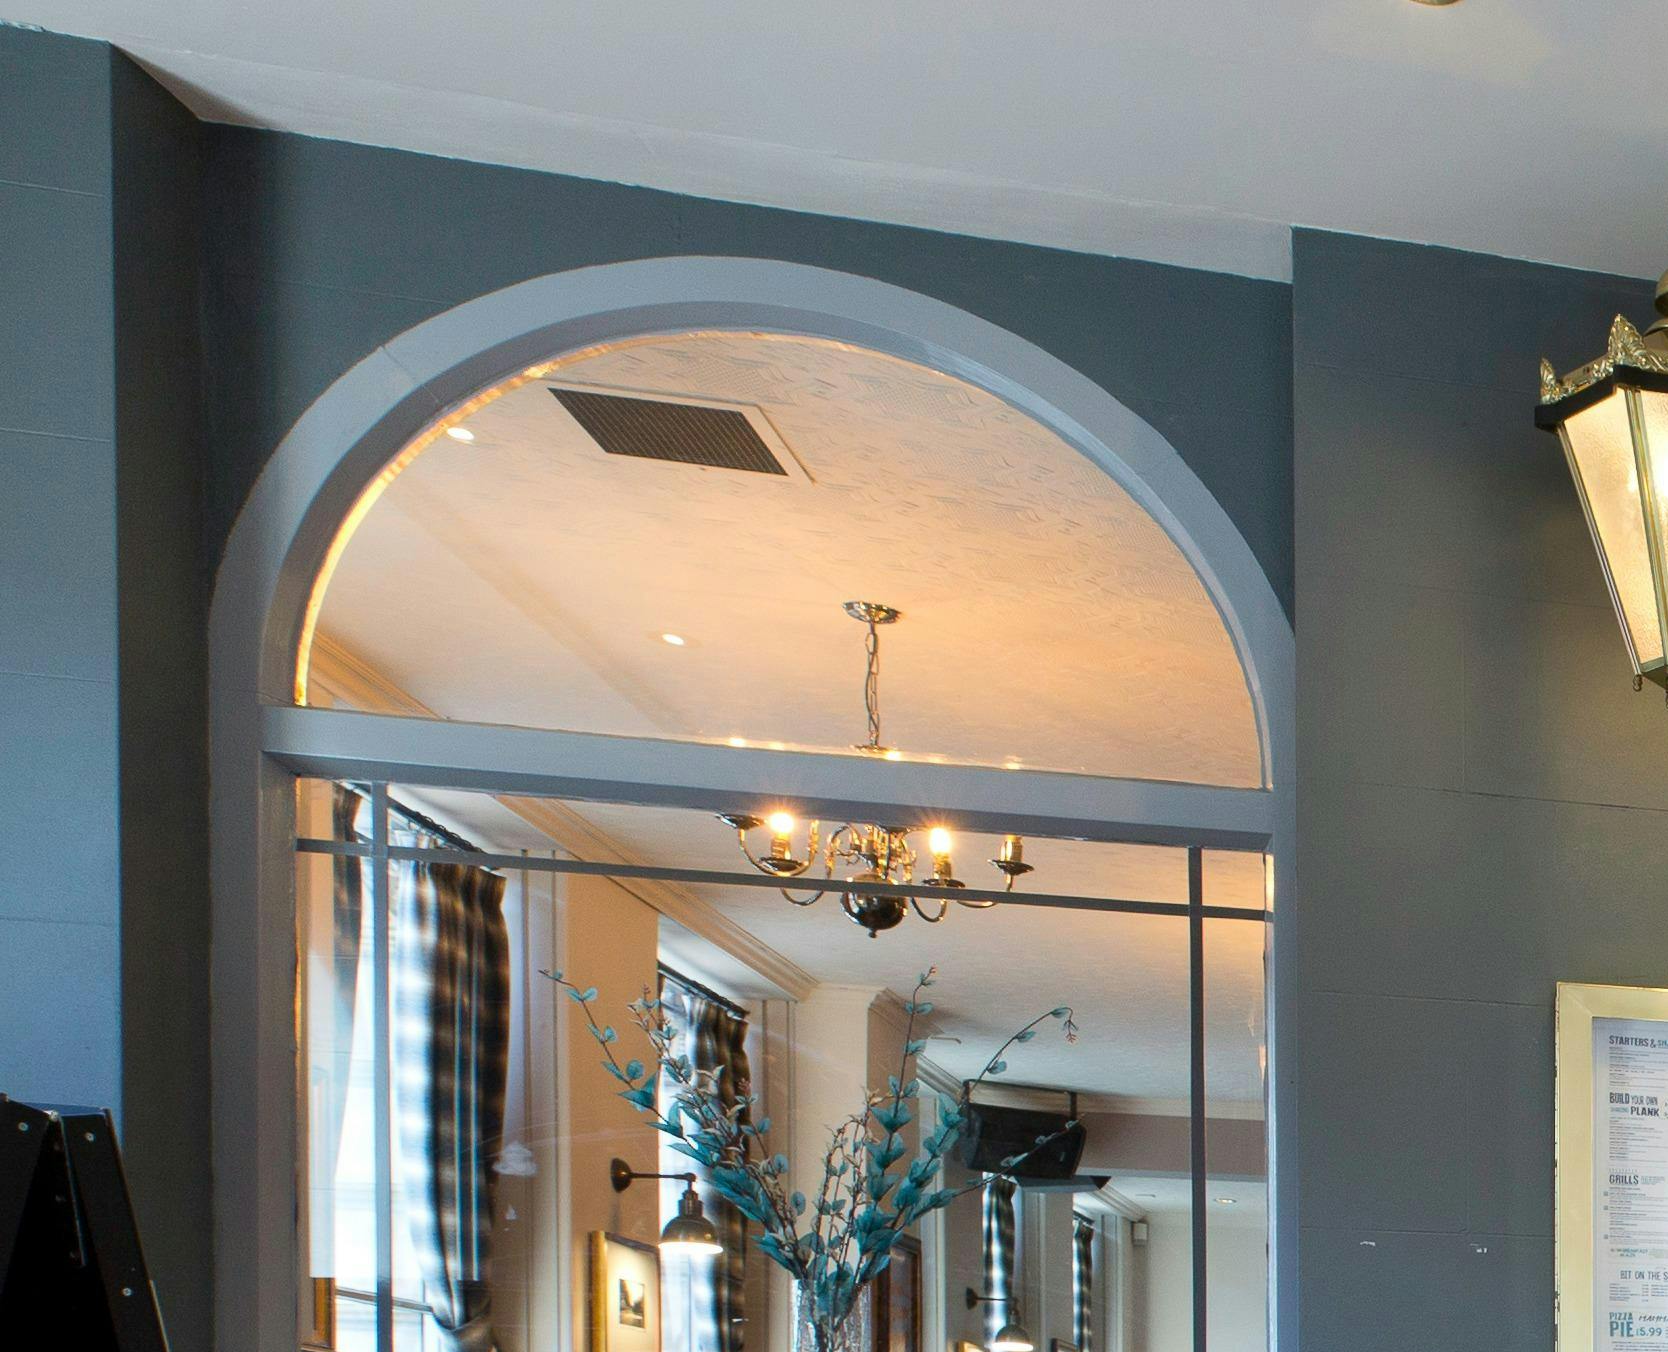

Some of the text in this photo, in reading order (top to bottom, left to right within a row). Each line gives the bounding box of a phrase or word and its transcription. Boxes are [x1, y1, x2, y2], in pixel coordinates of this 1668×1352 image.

[1609, 1035, 1649, 1047] STARTERS
[1631, 1106, 1659, 1116] PLANK
[1609, 1174, 1639, 1185] GRILLS
[1648, 1270, 1661, 1280] THE
[1609, 1321, 1634, 1337] PIE
